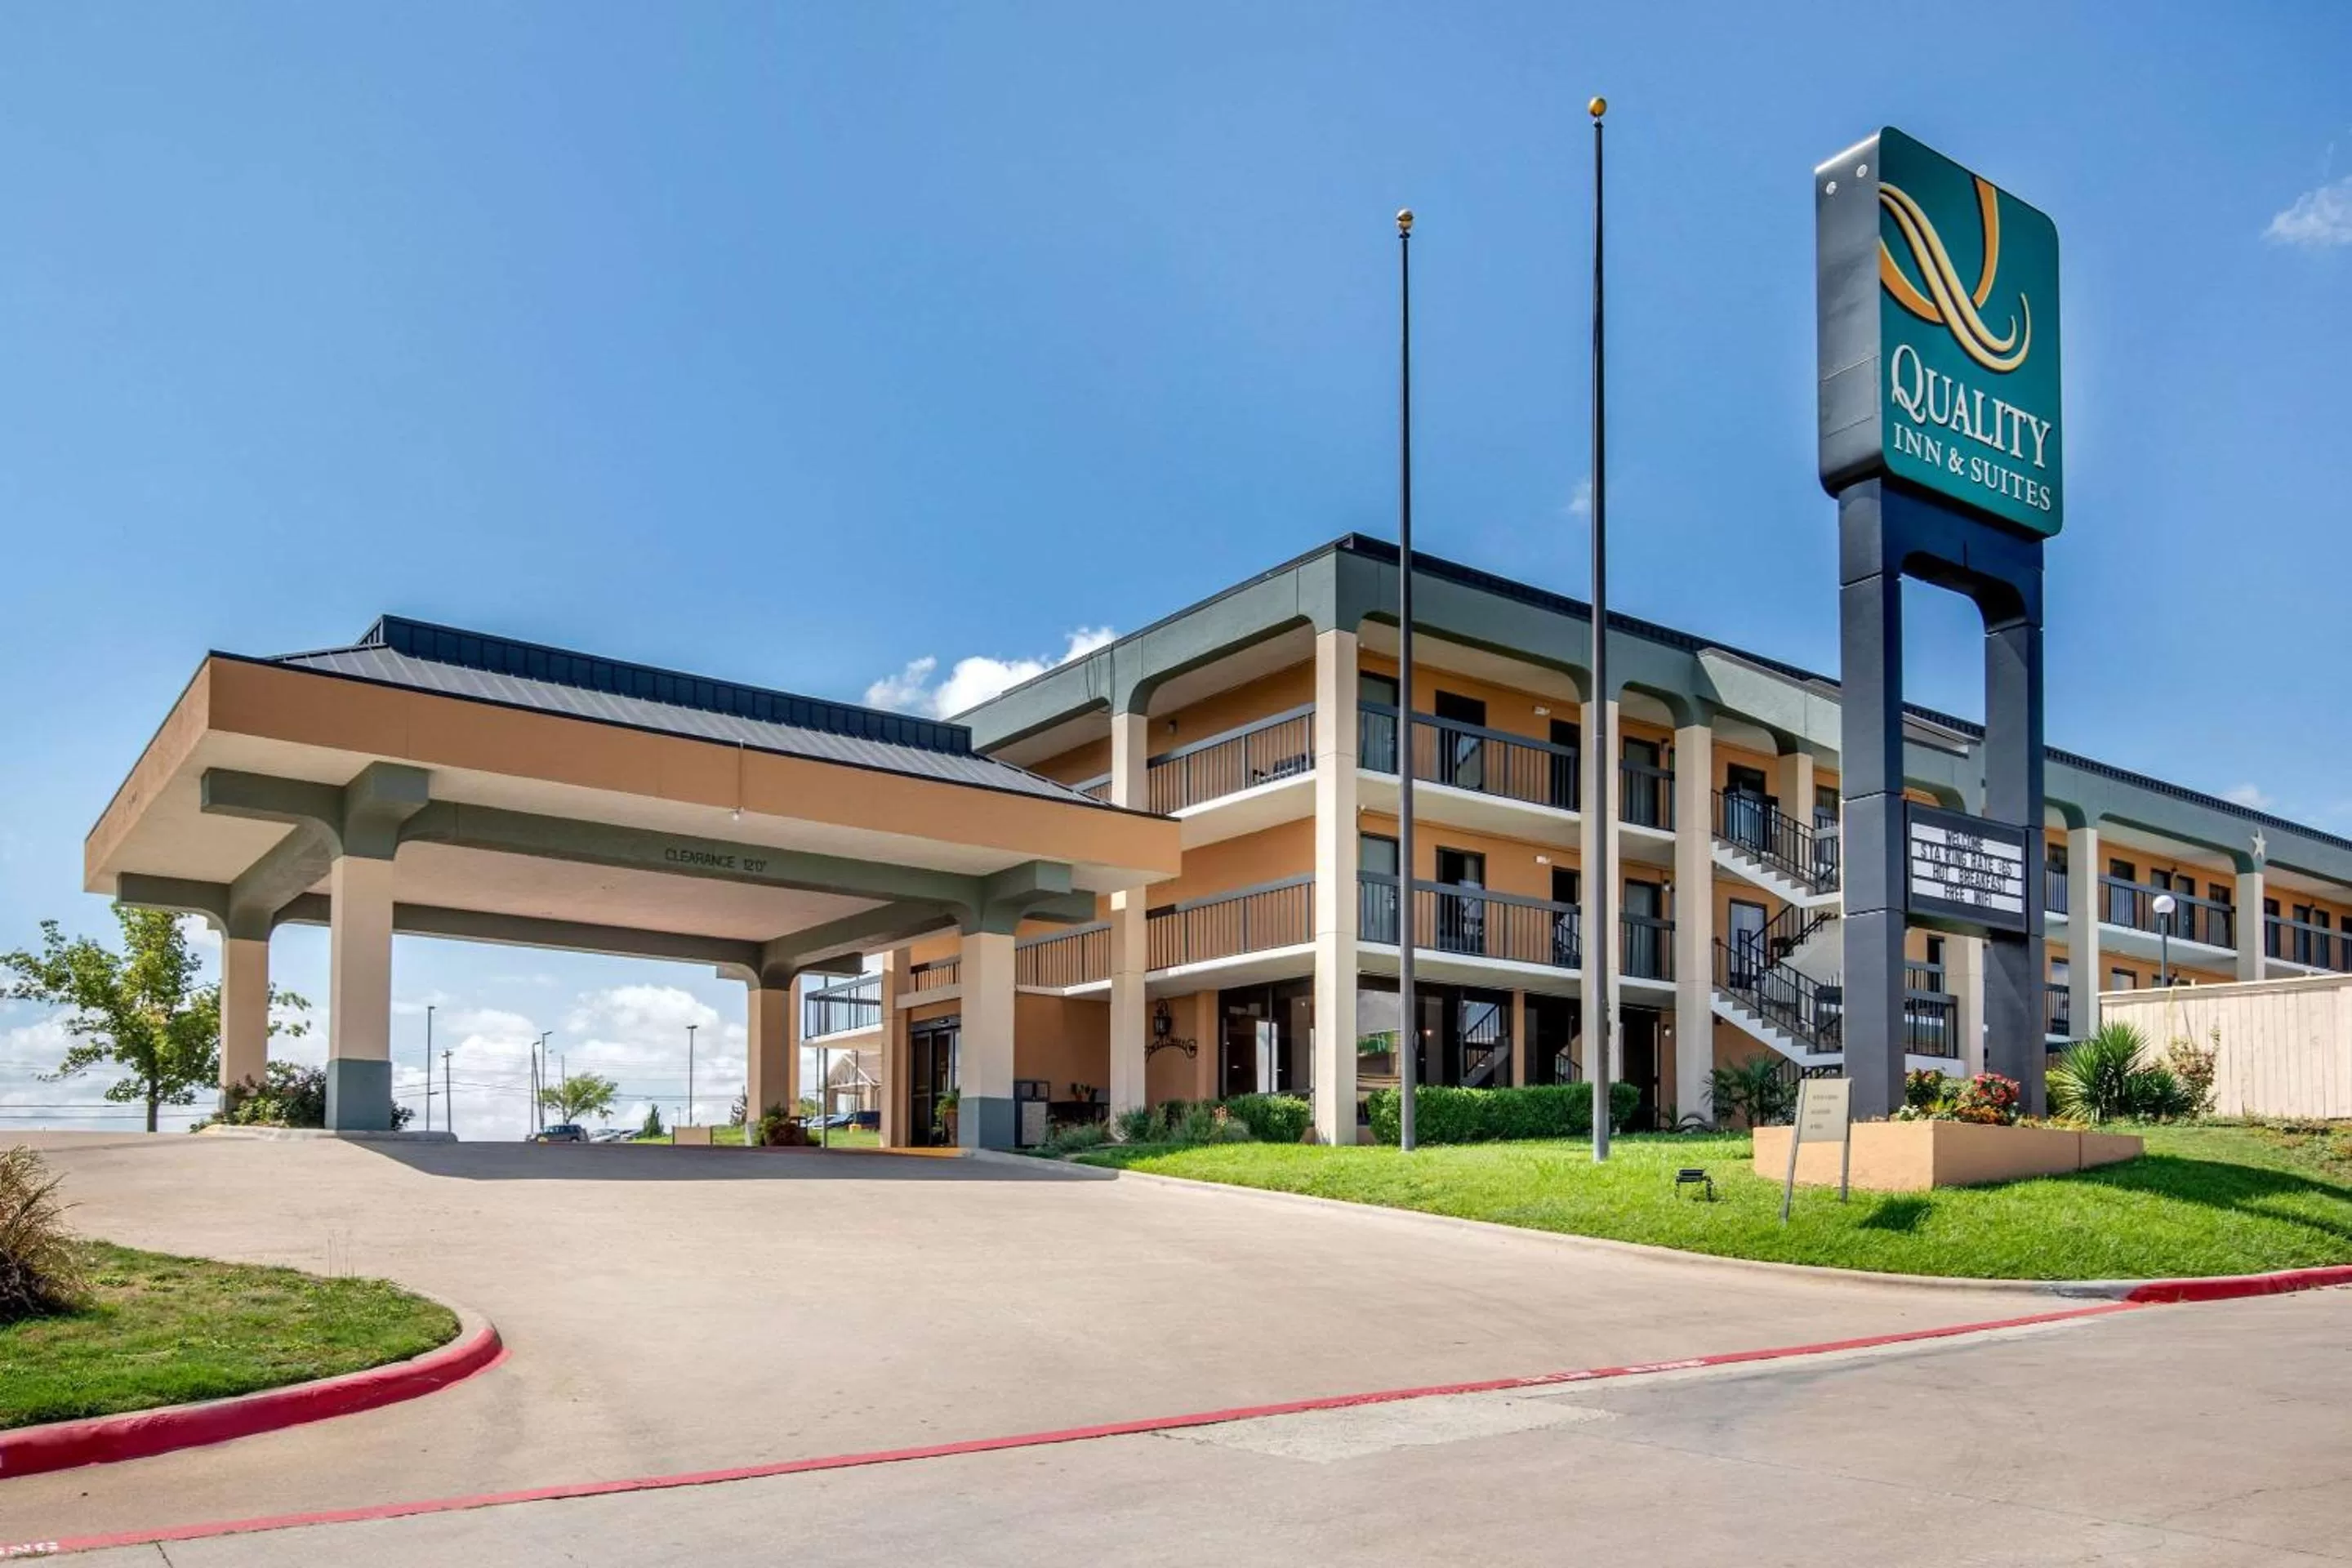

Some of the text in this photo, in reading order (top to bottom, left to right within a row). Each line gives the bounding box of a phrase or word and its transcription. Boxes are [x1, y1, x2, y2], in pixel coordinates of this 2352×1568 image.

[1891, 344, 2051, 468] QUALITY
[1893, 422, 2051, 511] INN & SUITES
[665, 848, 736, 868] CLEARANCE
[1971, 853, 1993, 872] RATE
[1933, 862, 2006, 893] HOT BREAKFAST
[1944, 884, 1992, 907] FREE WIFI
